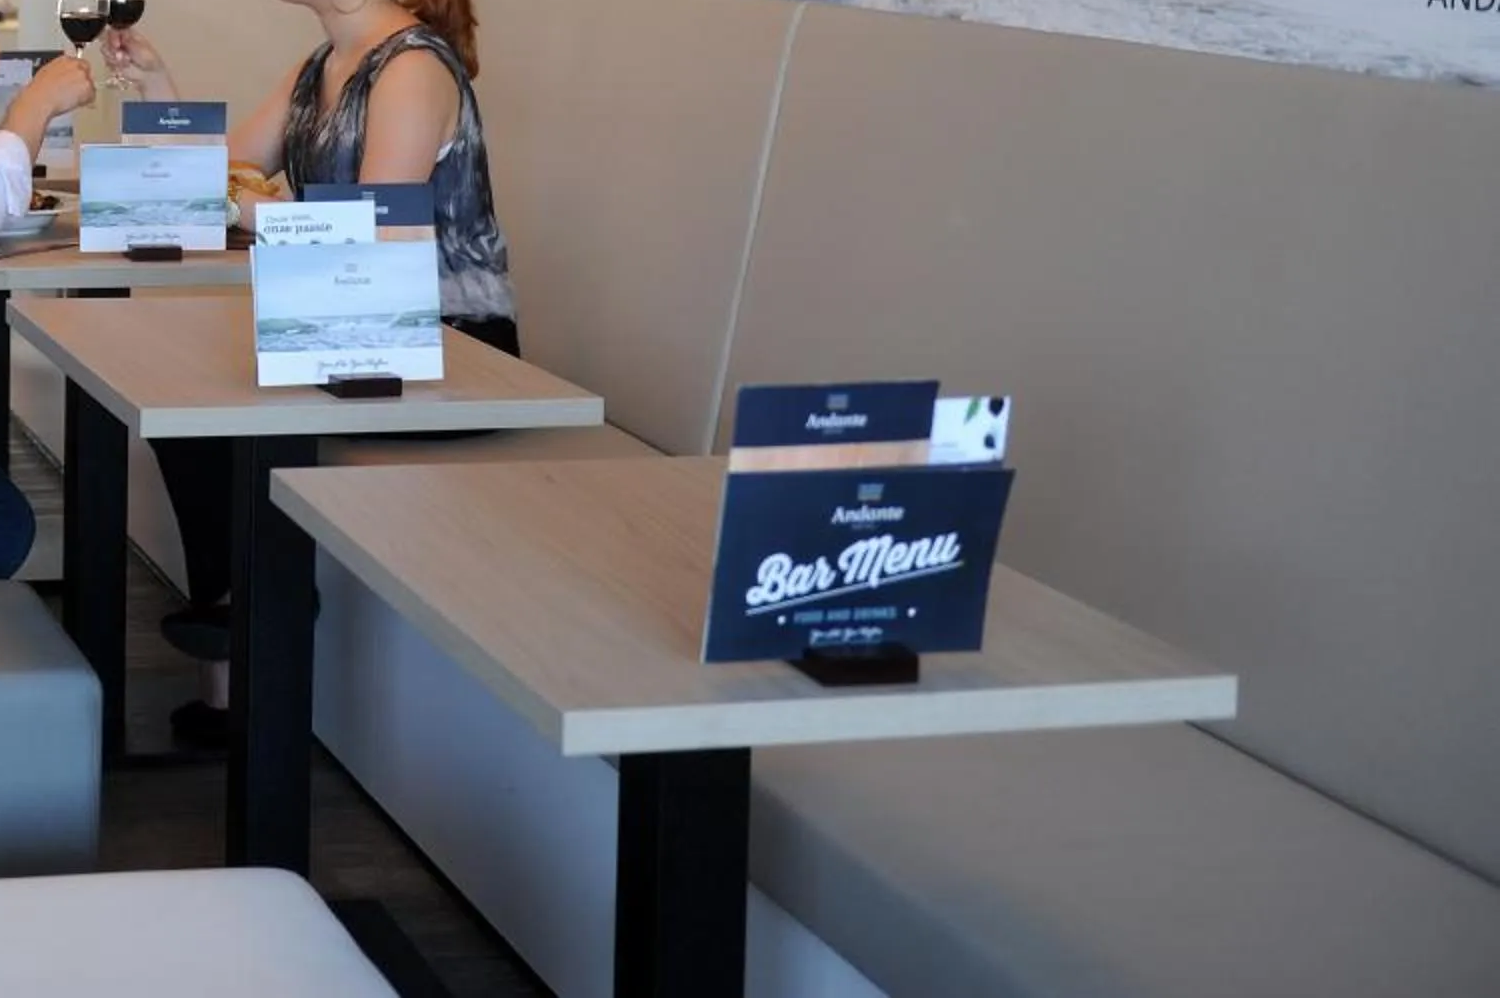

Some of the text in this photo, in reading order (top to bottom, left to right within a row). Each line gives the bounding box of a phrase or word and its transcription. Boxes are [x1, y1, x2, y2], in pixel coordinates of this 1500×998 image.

[805, 412, 868, 429] Andante
[831, 503, 905, 525] Andante
[745, 531, 962, 606] Bar Menu
